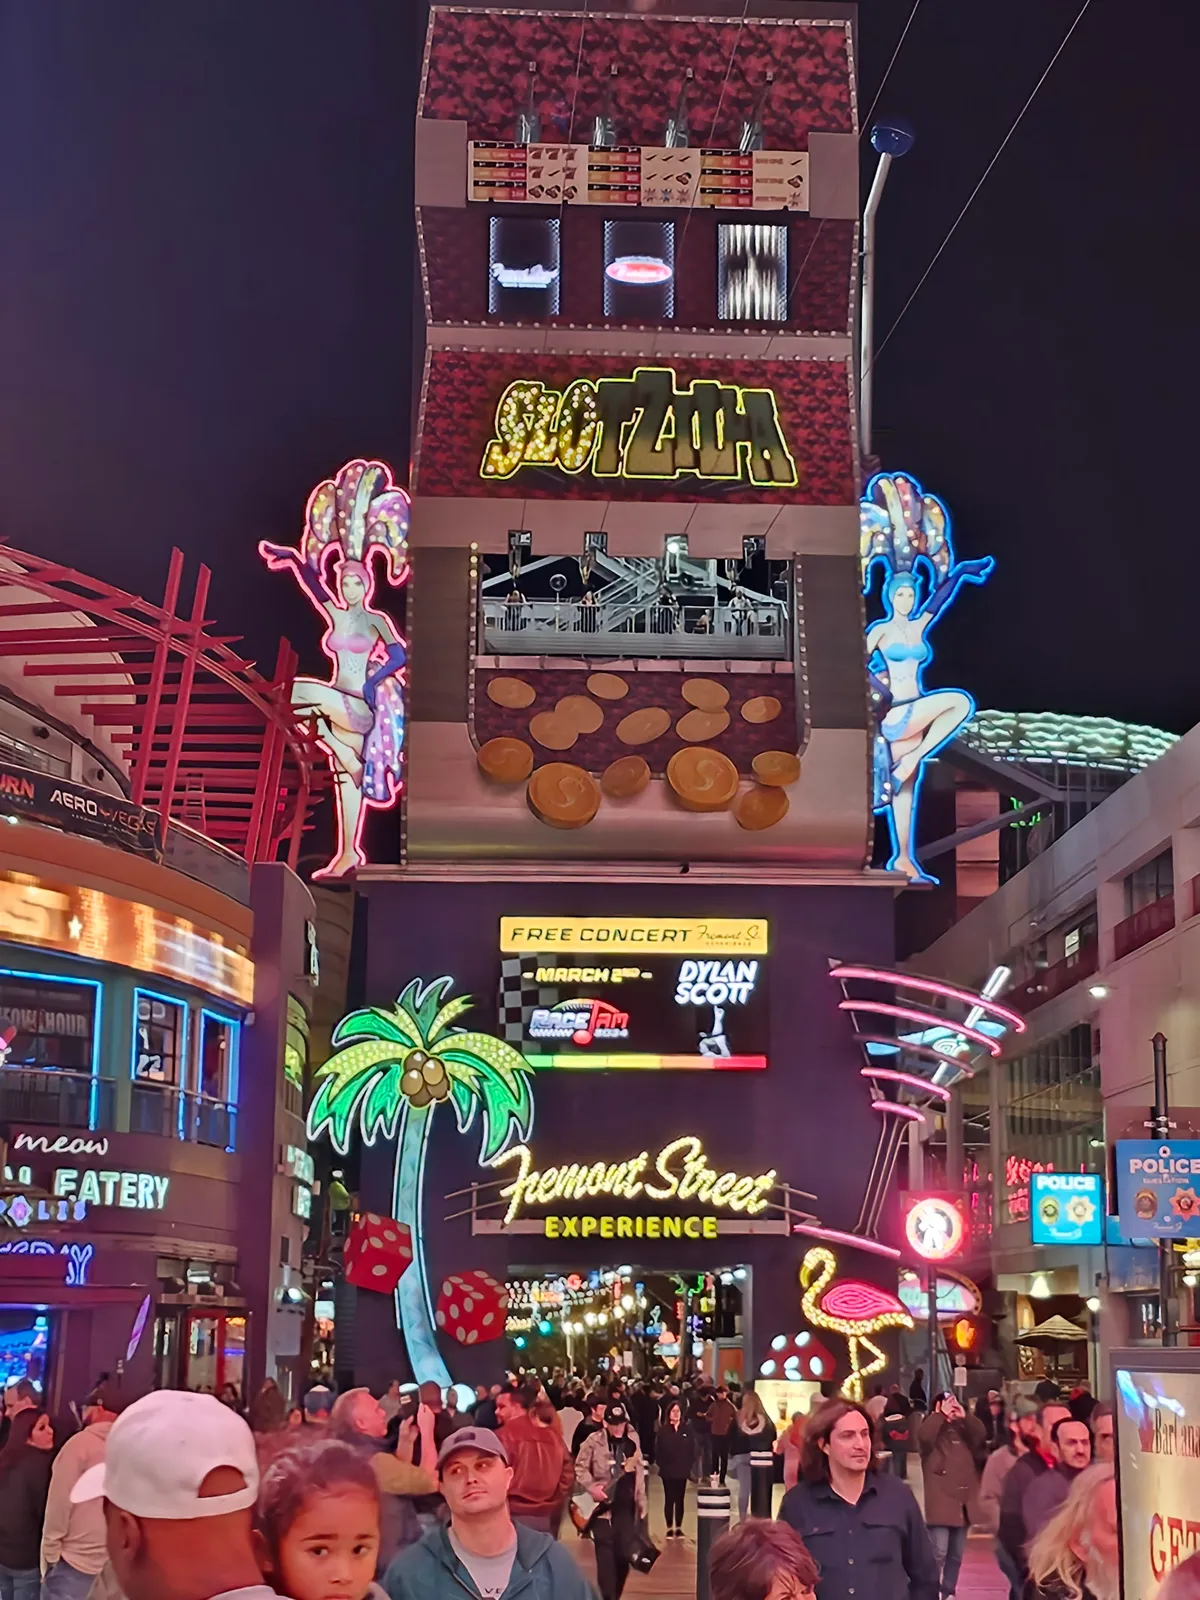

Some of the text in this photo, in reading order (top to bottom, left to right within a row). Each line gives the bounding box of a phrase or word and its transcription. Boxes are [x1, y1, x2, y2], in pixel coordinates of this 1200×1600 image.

[50, 789, 98, 816] AERO
[510, 927, 692, 942] FREE CONCERT
[535, 967, 609, 983] MARCH
[678, 960, 758, 983] DYLAN
[674, 982, 754, 1005] SCOTT
[14, 1133, 108, 1155] meow
[1129, 1158, 1200, 1174] POLICE
[54, 1168, 169, 1209] EATERY
[491, 1136, 777, 1226] Fremont Street
[1036, 1175, 1096, 1191] POLICE
[545, 1216, 718, 1238] EXPERIENCE
